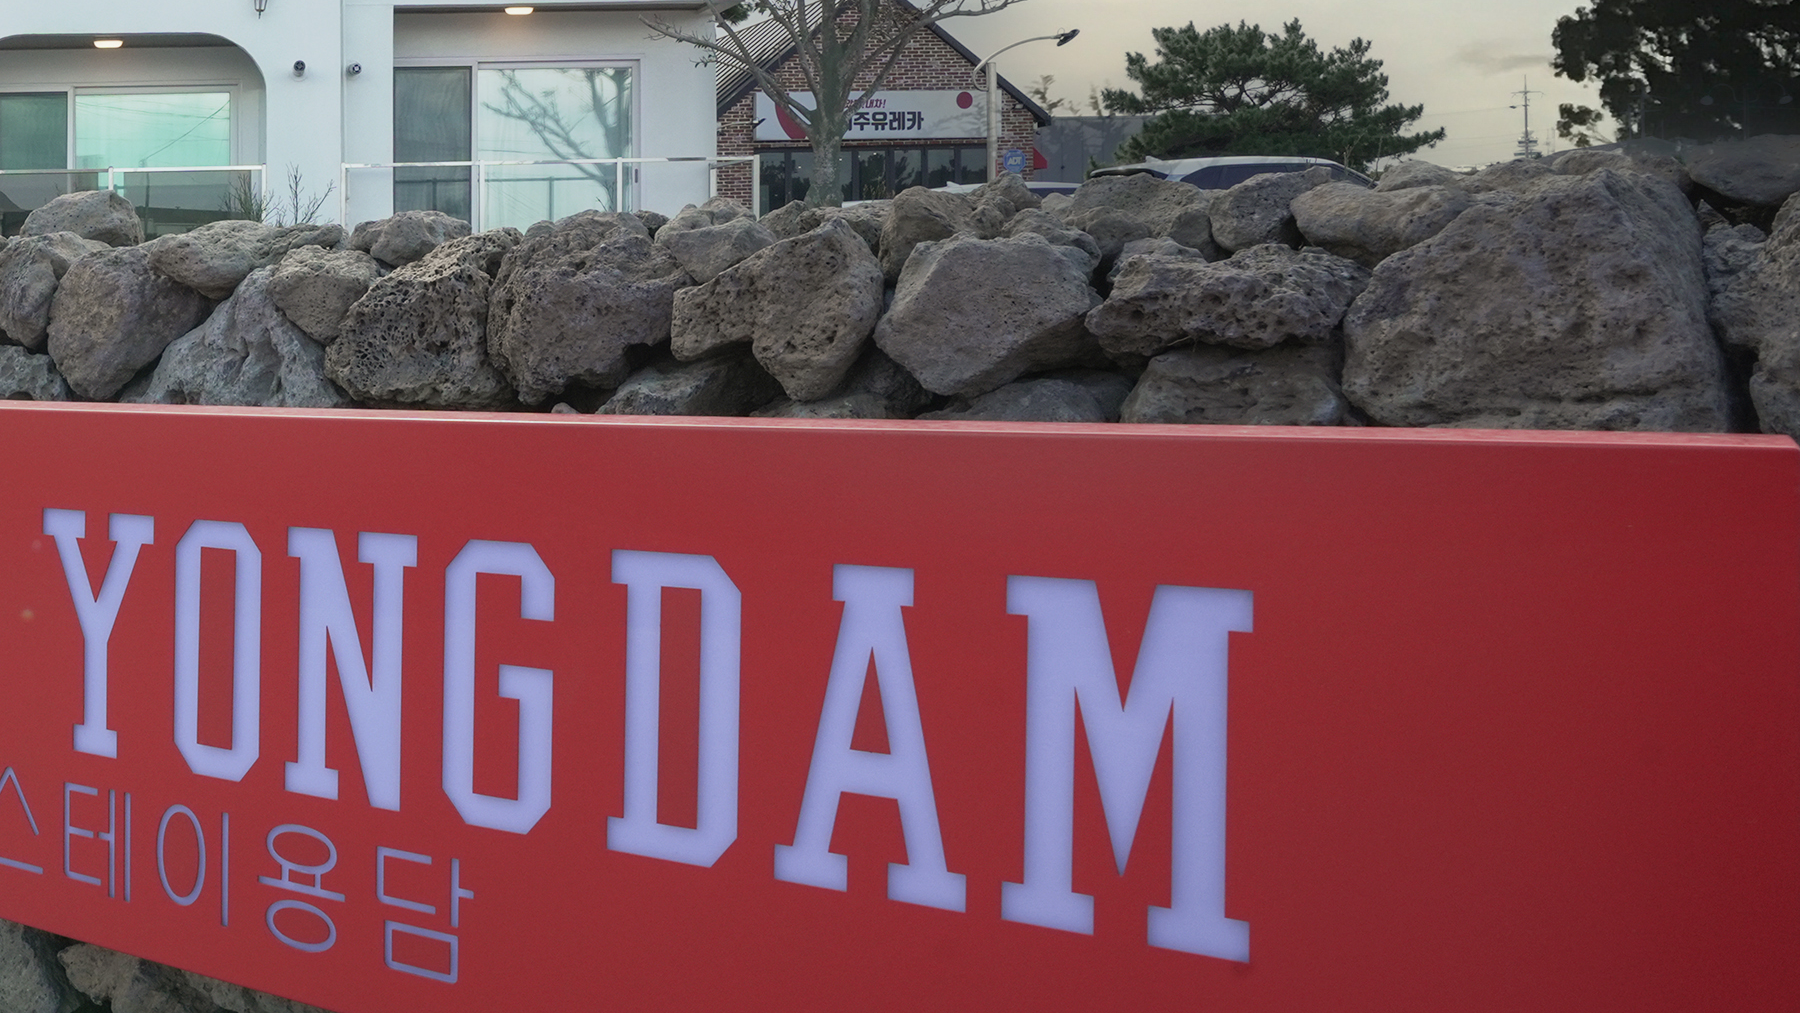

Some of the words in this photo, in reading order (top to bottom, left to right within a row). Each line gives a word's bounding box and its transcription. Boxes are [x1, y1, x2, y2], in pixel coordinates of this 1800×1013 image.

[848, 111, 924, 131] 주유레카
[1007, 156, 1023, 166] ADT
[43, 507, 1255, 963] YONGDAM
